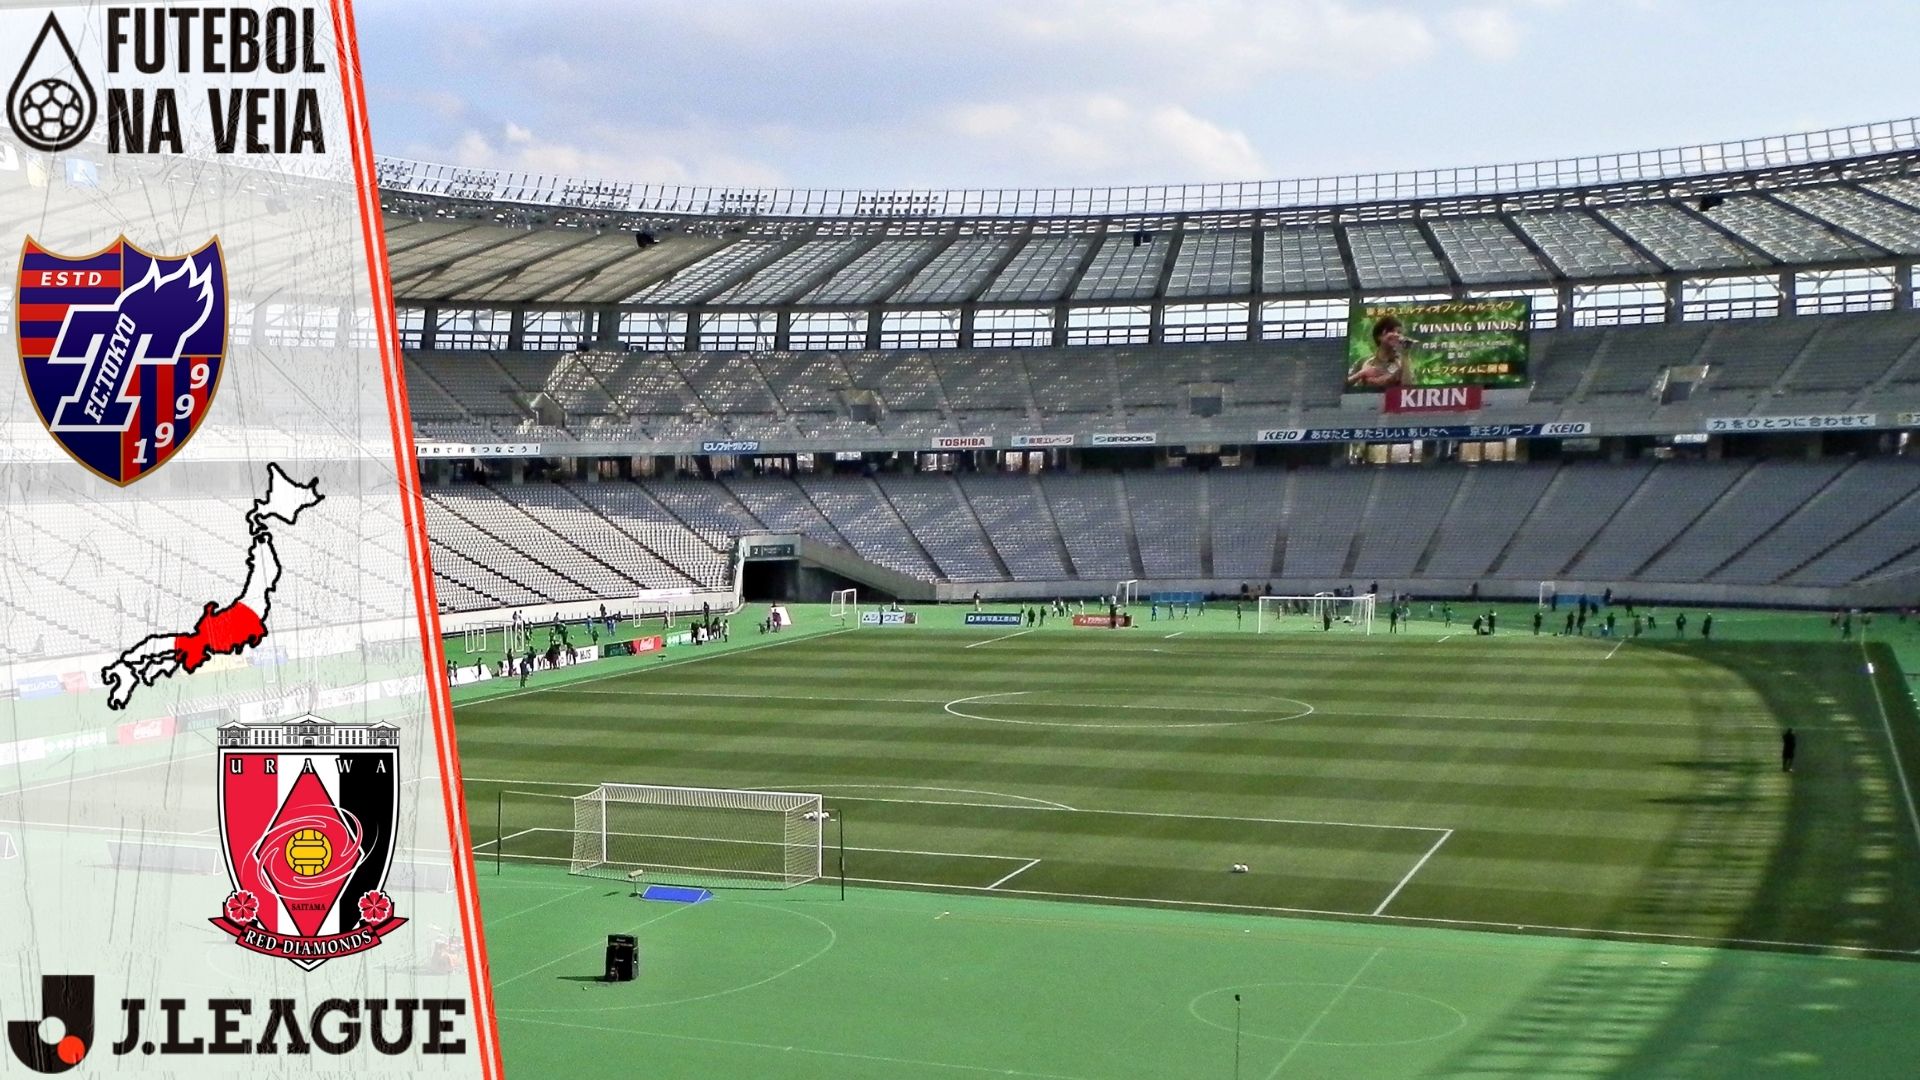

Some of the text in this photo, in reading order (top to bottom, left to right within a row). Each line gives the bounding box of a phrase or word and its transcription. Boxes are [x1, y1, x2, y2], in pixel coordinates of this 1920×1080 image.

[1399, 387, 1468, 408] KIRIN
[1548, 423, 1587, 434] KEIO
[1263, 430, 1299, 440] KEIO
[1310, 430, 1351, 440] あなたと
[1353, 429, 1405, 439] あたらしい
[938, 437, 986, 447] TOSHIBA
